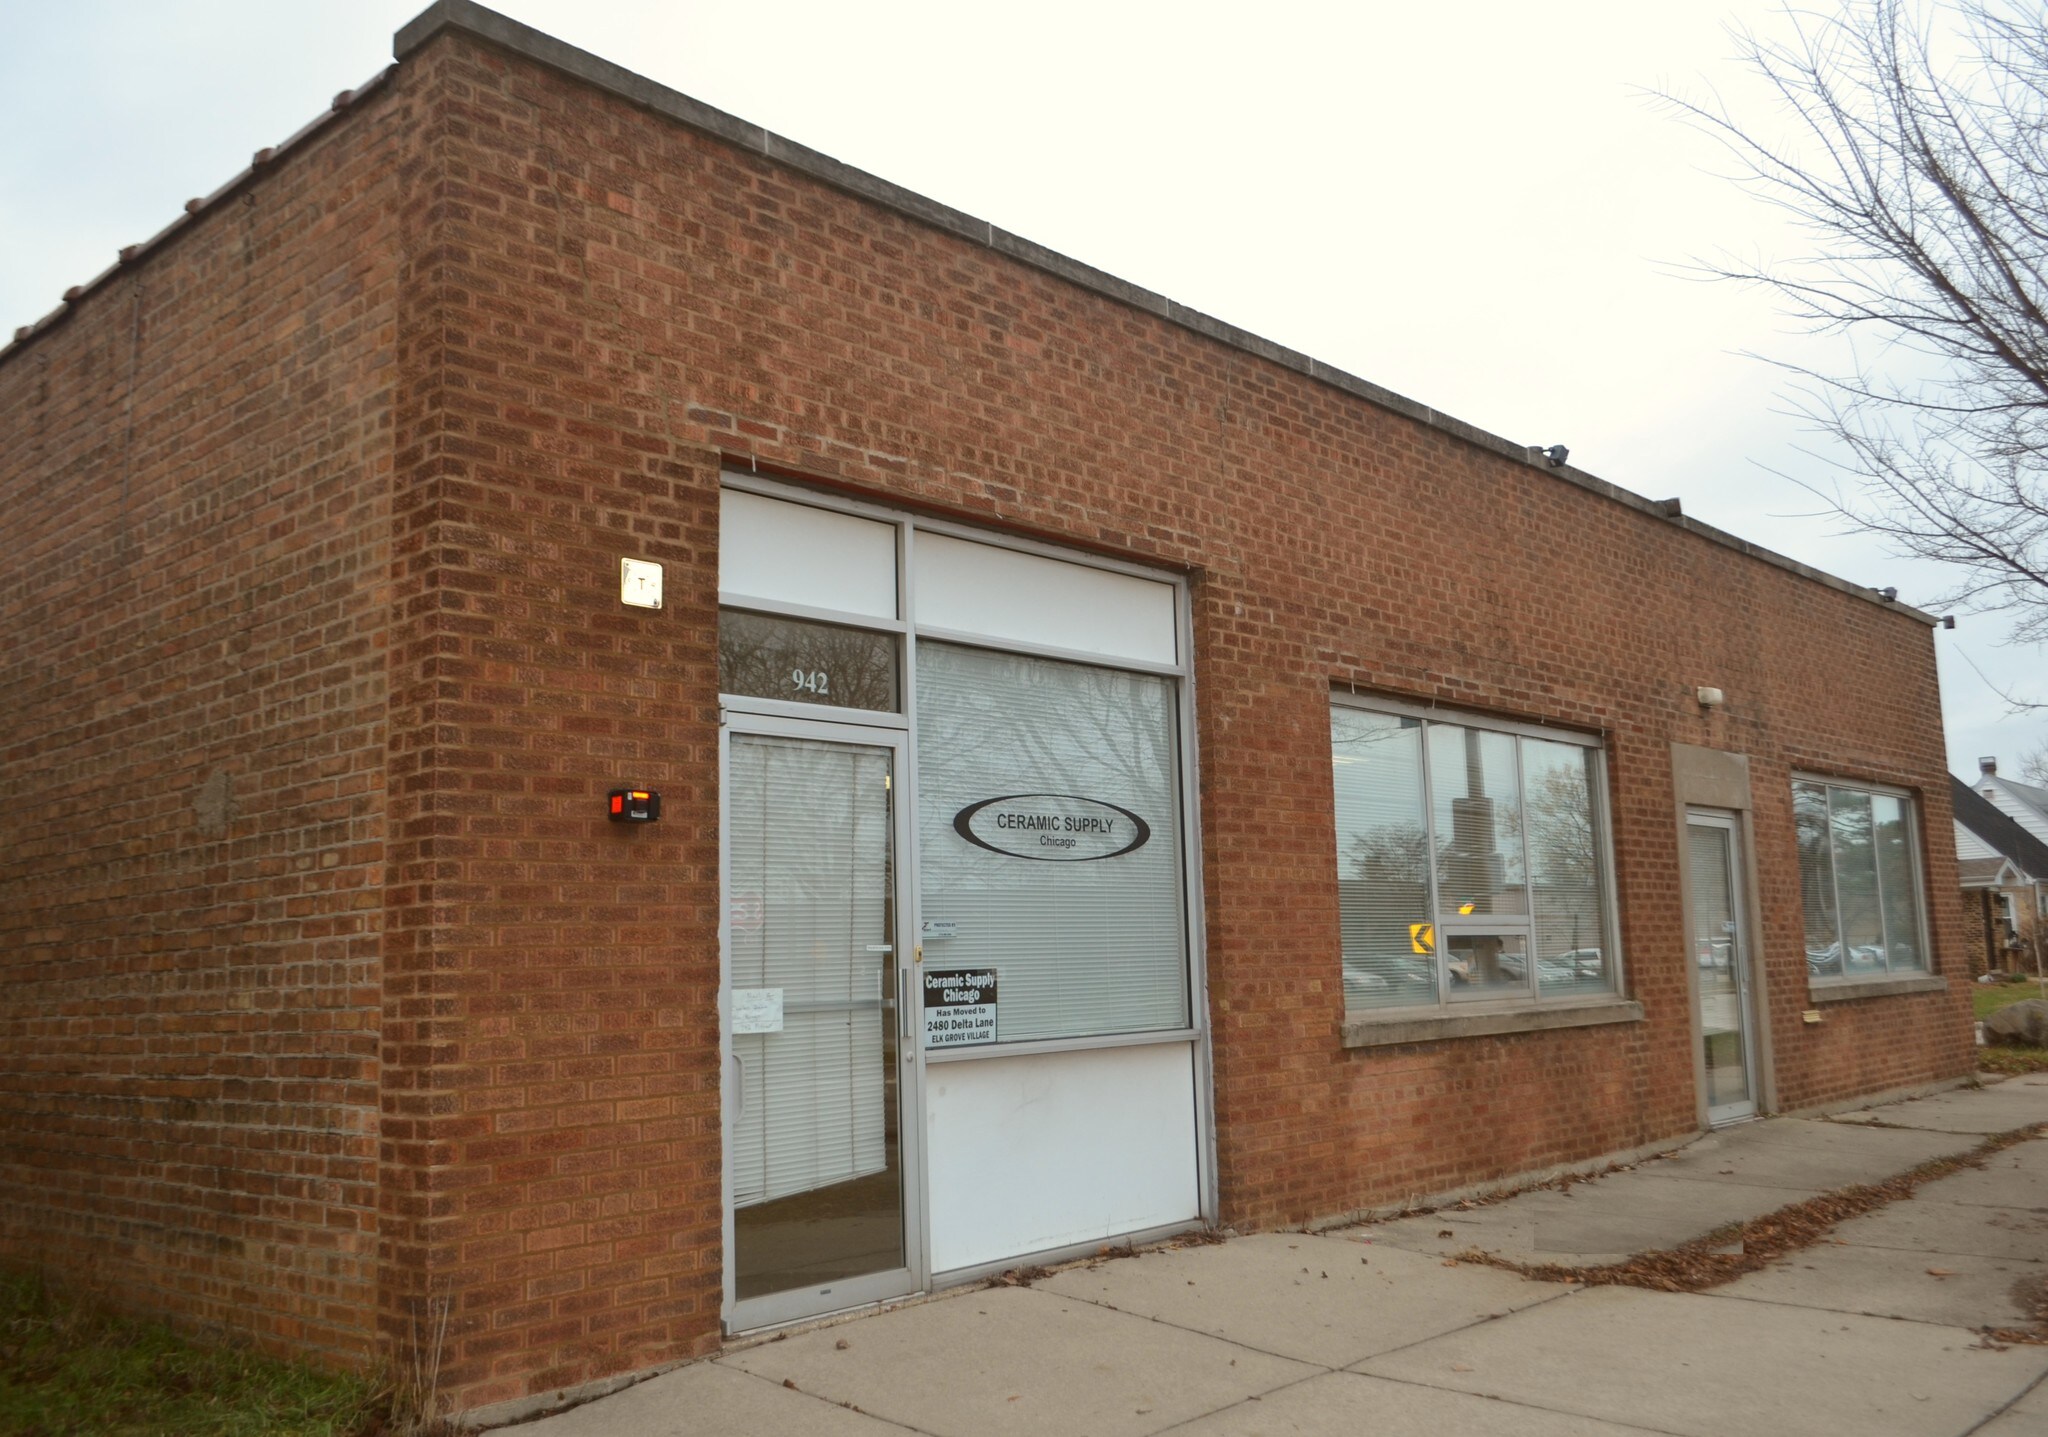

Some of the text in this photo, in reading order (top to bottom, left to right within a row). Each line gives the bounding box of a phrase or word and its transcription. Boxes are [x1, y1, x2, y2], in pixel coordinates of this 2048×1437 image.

[792, 669, 829, 695] 942
[997, 813, 1114, 833] CERAMIC SUPPLY
[1040, 835, 1076, 849] Chicago
[925, 972, 994, 989] Ceramic Supply
[943, 988, 980, 1003] Chicago
[936, 1009, 951, 1017] Has
[953, 1007, 977, 1016] Moved
[928, 1018, 994, 1032] 2480 Delta Lane
[931, 1030, 990, 1043] ELK GROVE VILLAGE
